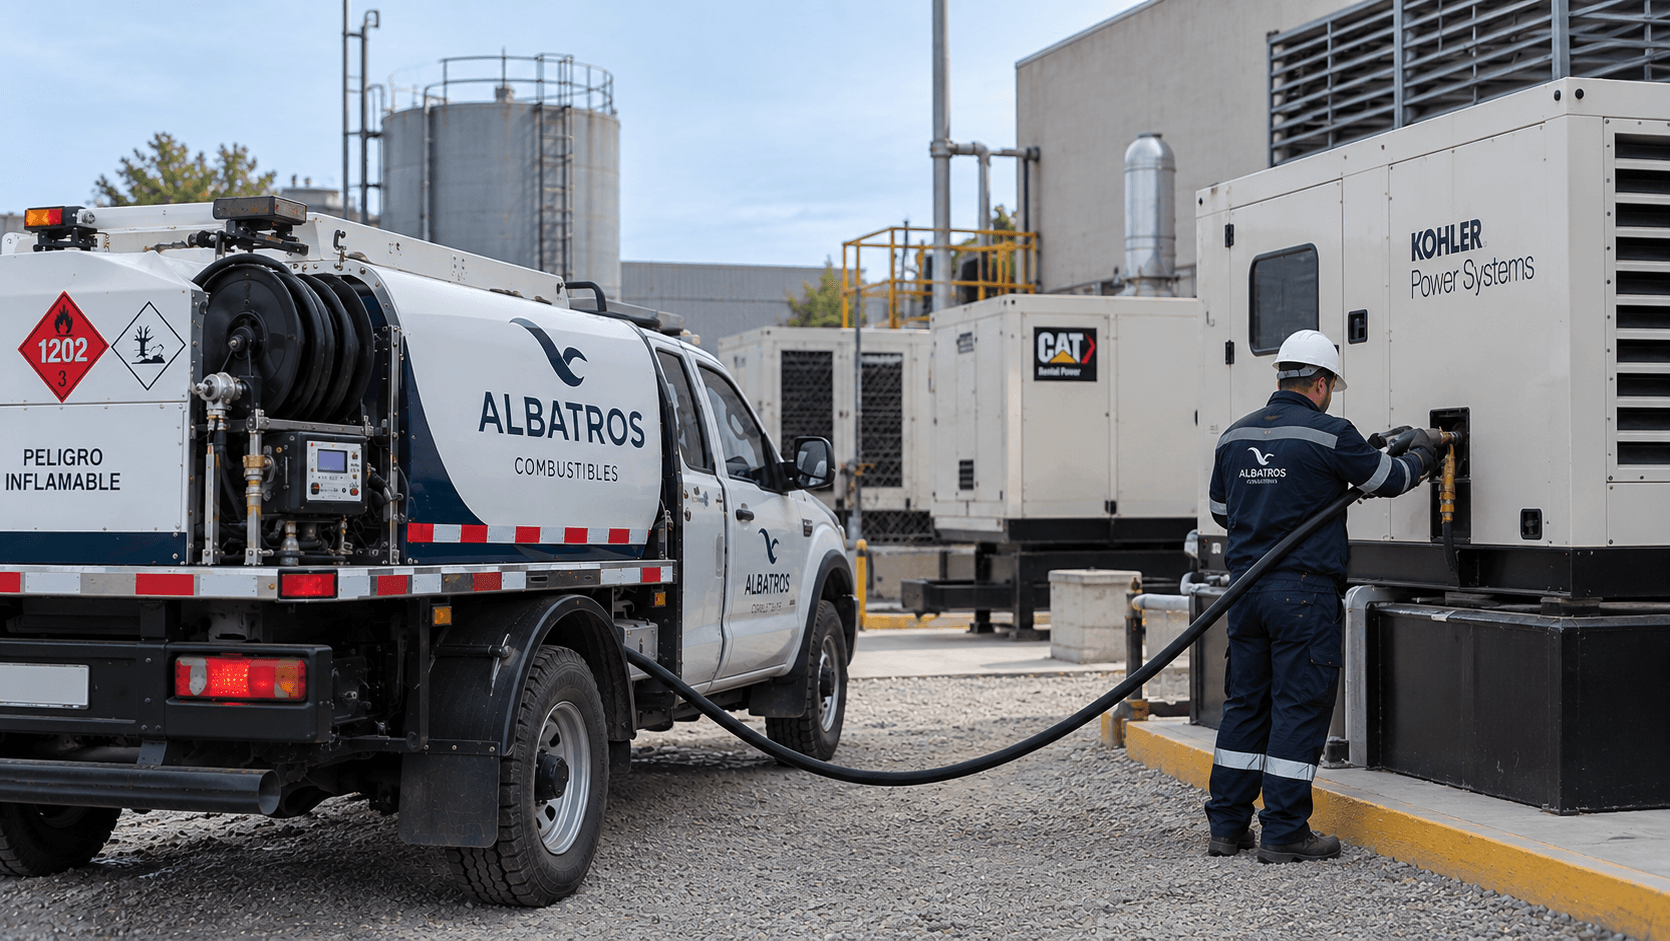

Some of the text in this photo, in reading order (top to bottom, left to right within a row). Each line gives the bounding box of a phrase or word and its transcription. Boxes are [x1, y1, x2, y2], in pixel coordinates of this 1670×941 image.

[1411, 218, 1483, 262] KOHLER
[1411, 255, 1535, 299] Power Systems
[38, 337, 88, 364] 1202
[1038, 331, 1084, 364] CAT
[58, 370, 67, 387] 3
[1038, 366, 1081, 376] Rental Power
[478, 391, 645, 448] ALBATROS
[23, 448, 103, 466] PELIGRO
[514, 456, 618, 482] COMBUSTIBLES
[5, 472, 121, 491] INFLAMABLE
[1238, 468, 1287, 478] ALBATROS
[744, 573, 790, 595] ALBATROS
